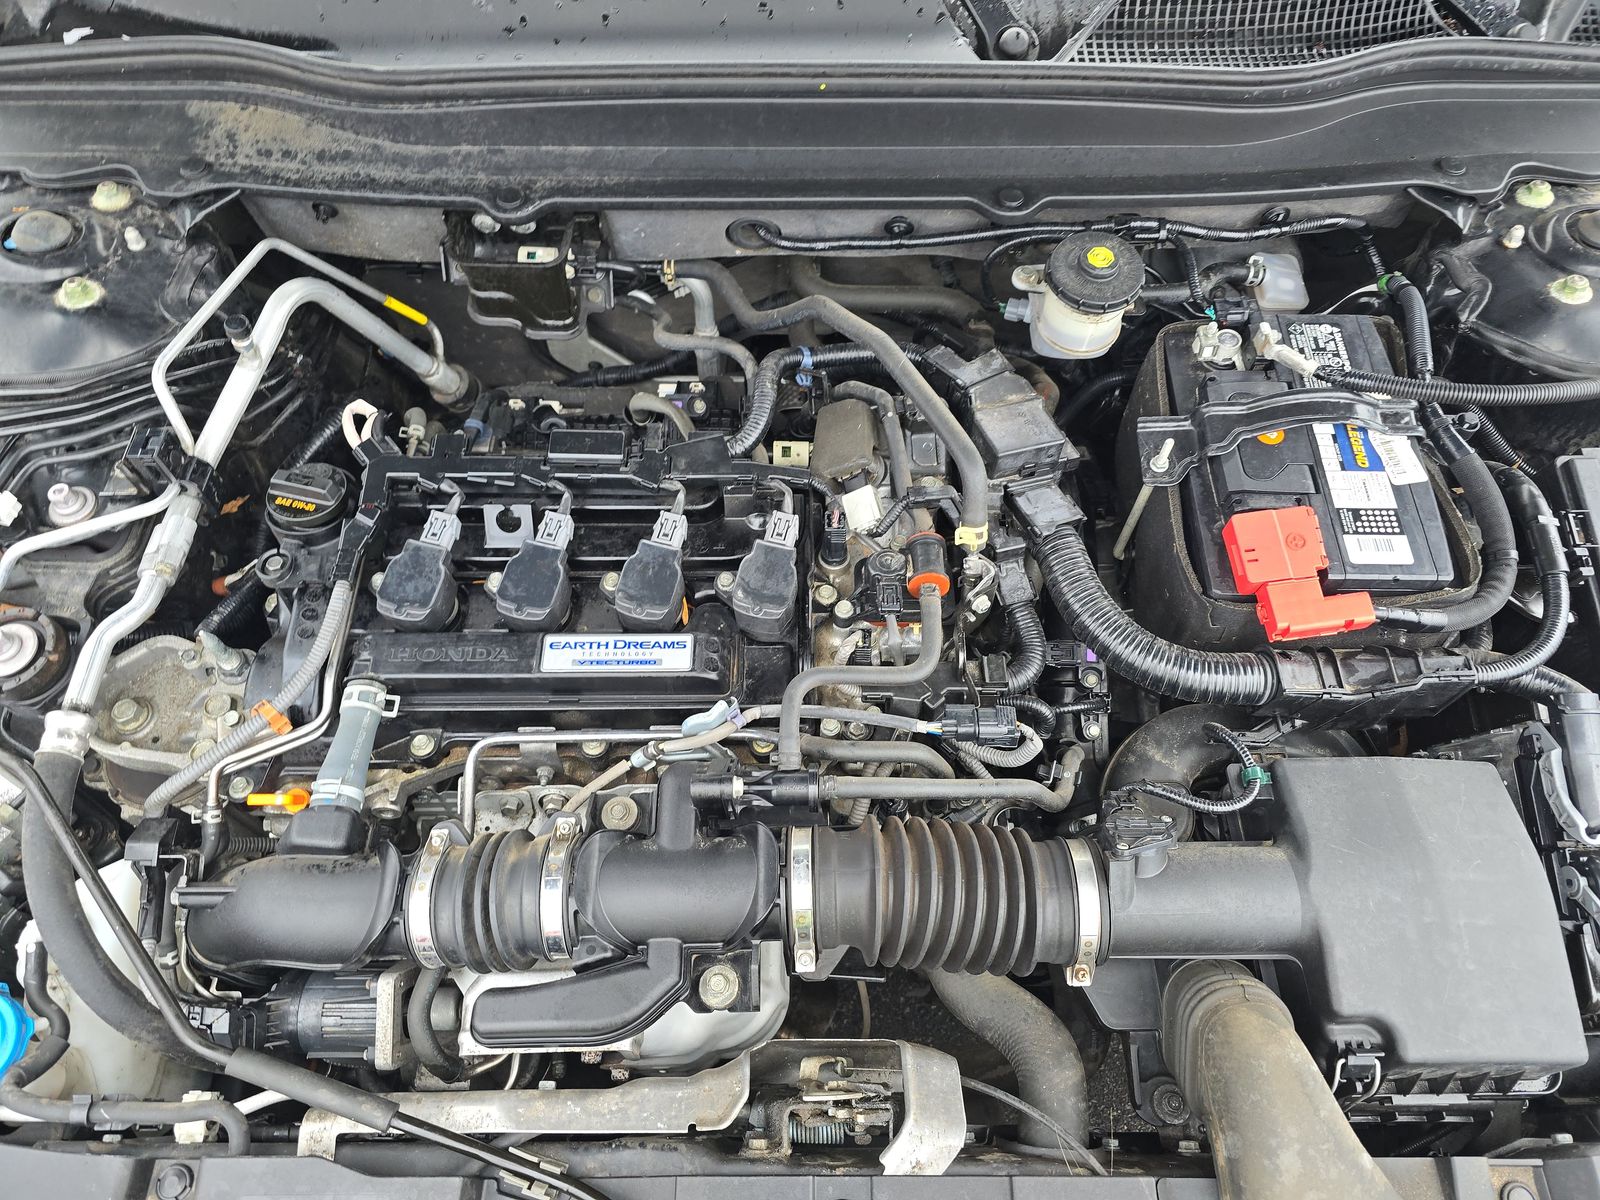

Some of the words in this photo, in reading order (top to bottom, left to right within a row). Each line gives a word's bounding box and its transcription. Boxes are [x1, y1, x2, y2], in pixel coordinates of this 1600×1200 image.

[1346, 423, 1370, 469] LEGEND
[549, 641, 609, 650] EARTH
[613, 639, 687, 650] DREAMS
[388, 647, 519, 662] HONDA
